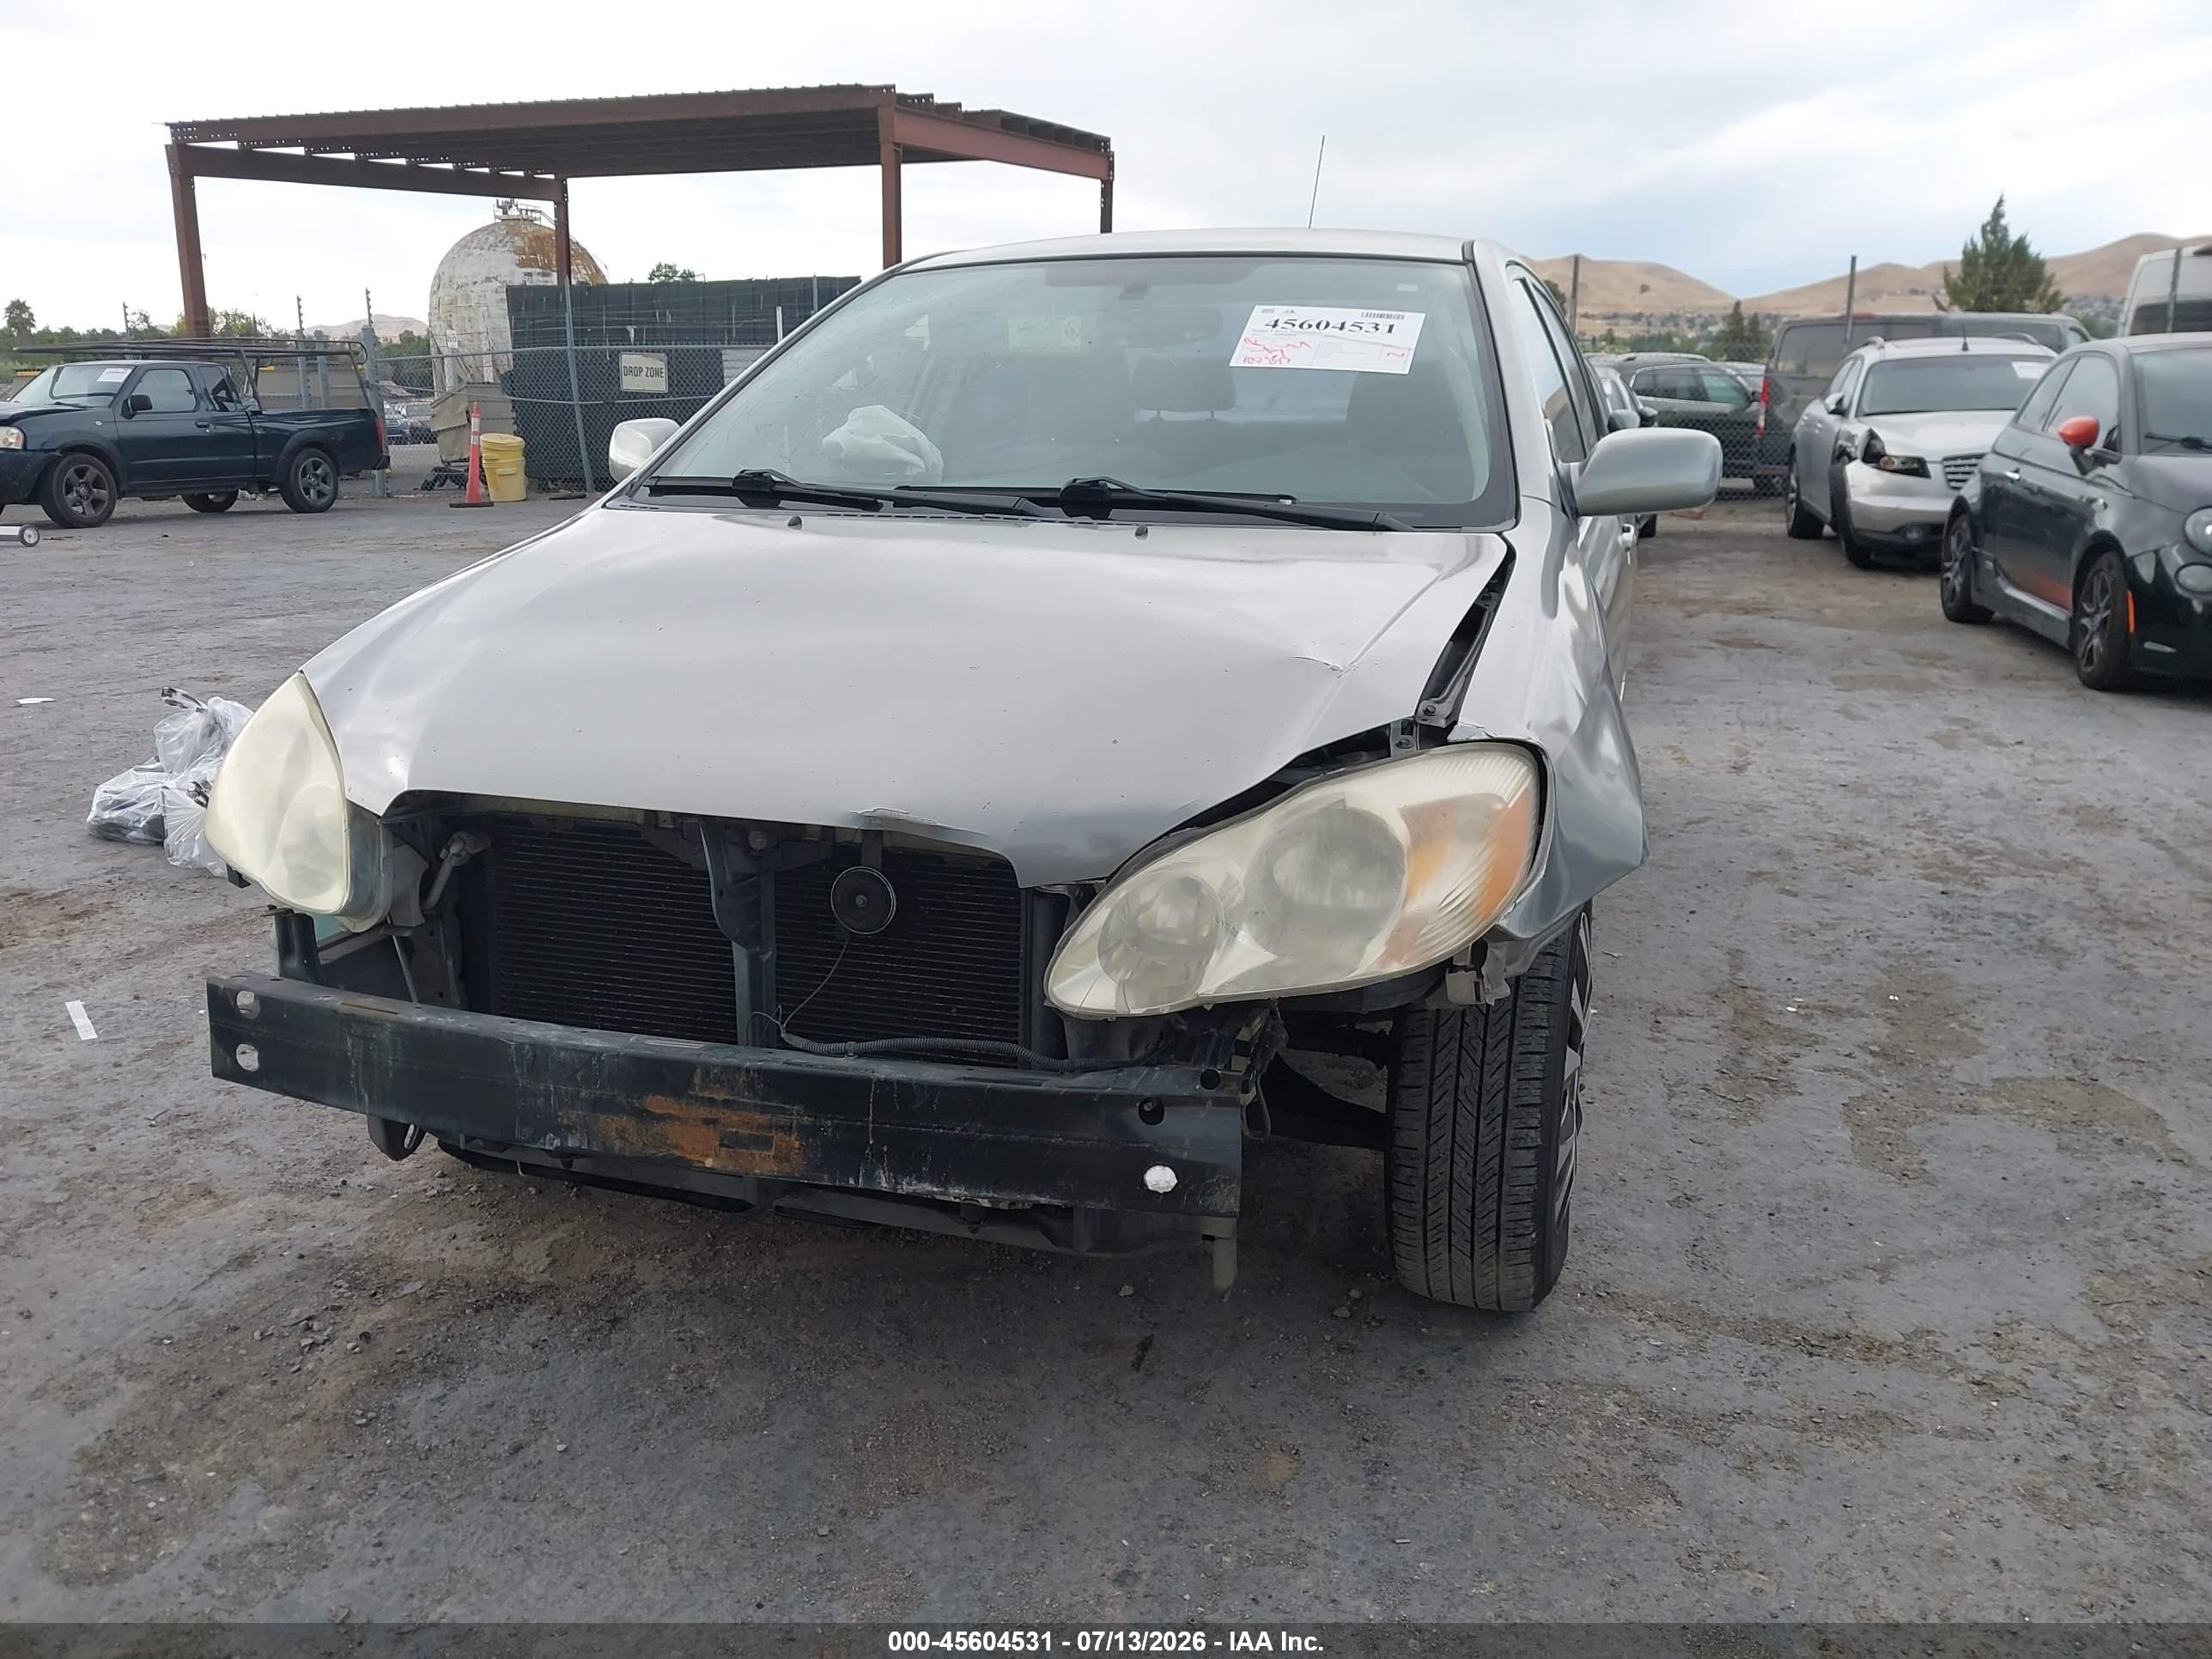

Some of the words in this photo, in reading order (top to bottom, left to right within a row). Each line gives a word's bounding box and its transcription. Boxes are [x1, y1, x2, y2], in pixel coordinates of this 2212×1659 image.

[1264, 318, 1395, 334] 45604531
[623, 365, 643, 377] DROP
[645, 367, 665, 378] ZONE
